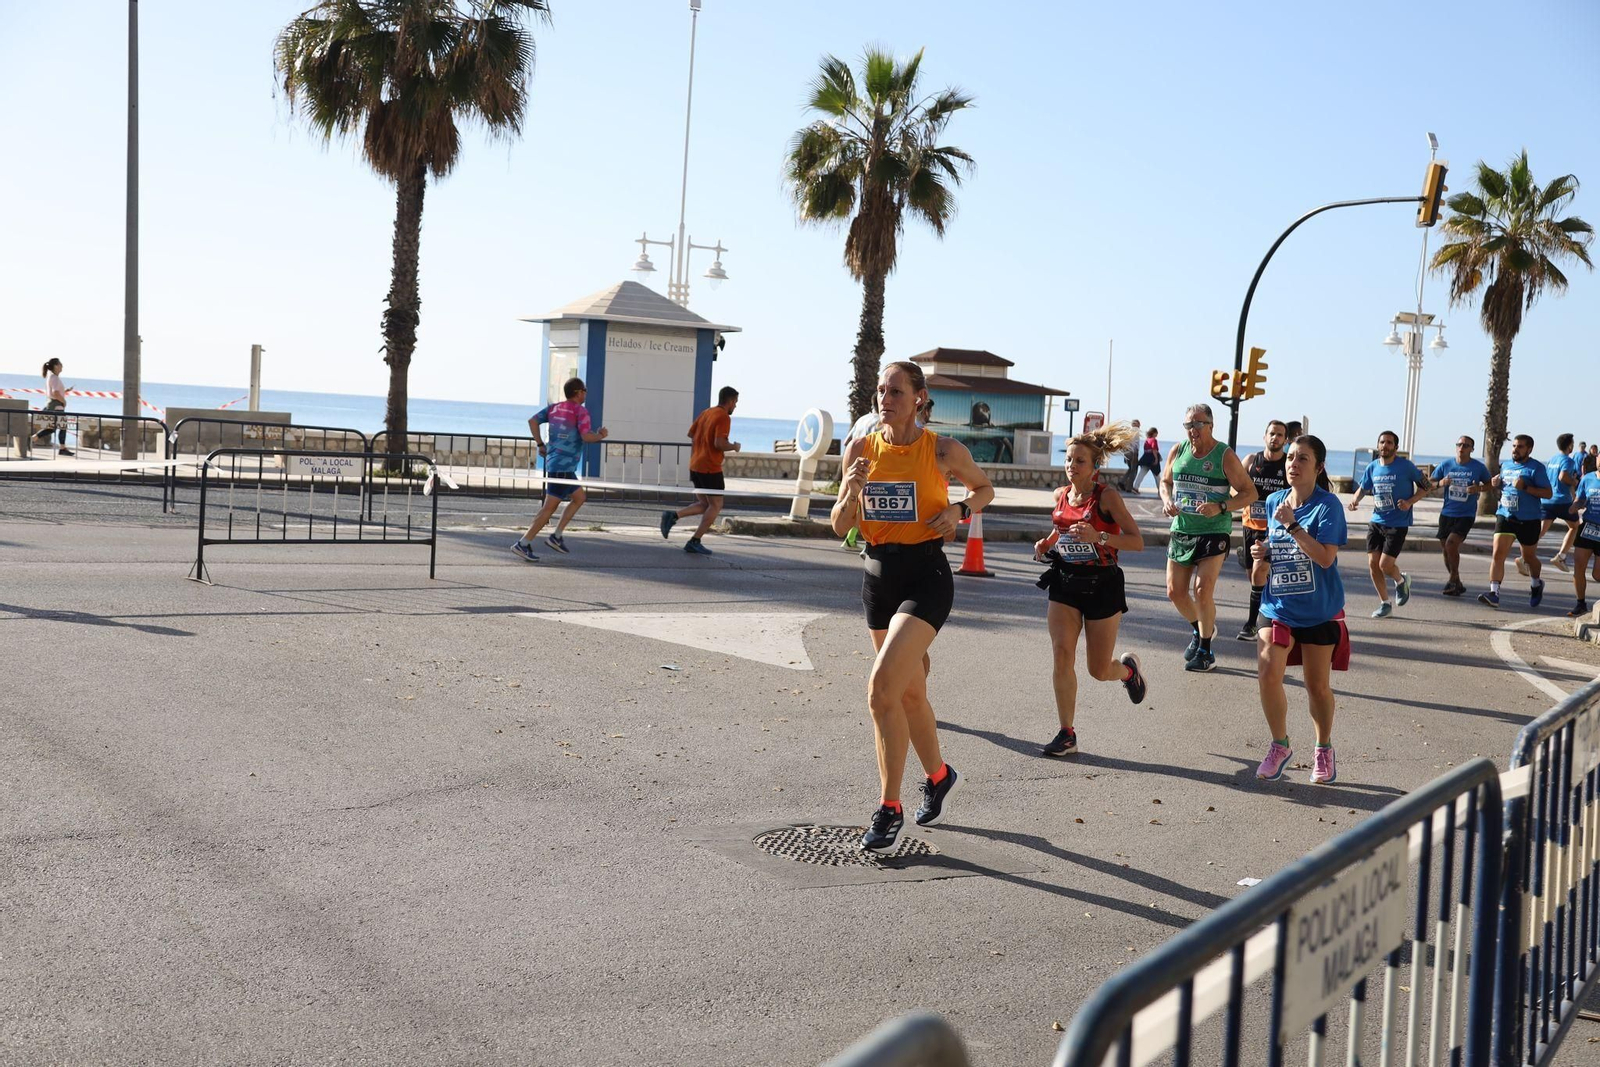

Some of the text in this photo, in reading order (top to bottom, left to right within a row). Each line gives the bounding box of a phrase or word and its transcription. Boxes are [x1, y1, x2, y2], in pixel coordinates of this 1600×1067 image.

[608, 337, 642, 349] Helados
[649, 340, 662, 351] Ice
[664, 341, 694, 353] Creams
[1177, 474, 1209, 484] ATLETISMO
[1253, 477, 1284, 485] VALENCIA
[868, 497, 909, 509] 1867
[1060, 544, 1091, 553] 1602
[1273, 572, 1308, 584] 1905
[1297, 853, 1401, 962] POLICIA LOCAL
[1321, 917, 1379, 999] MALAGA
